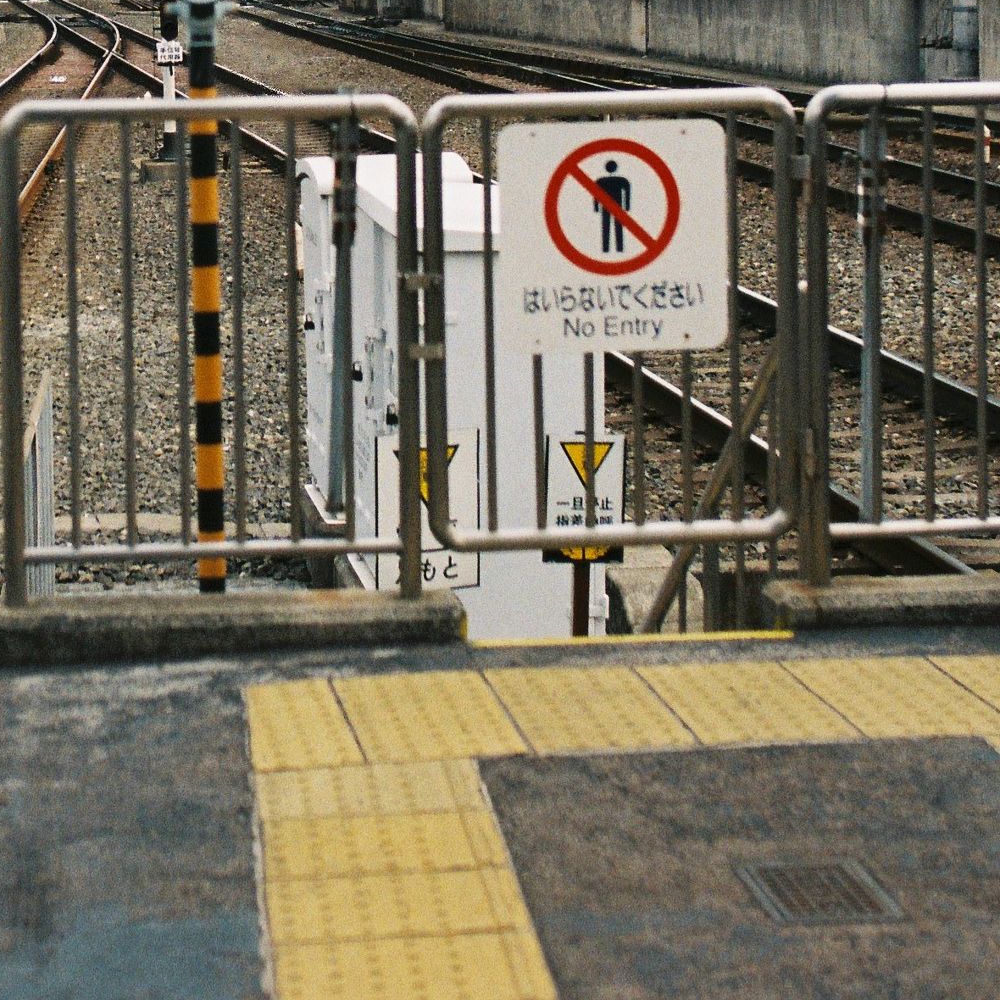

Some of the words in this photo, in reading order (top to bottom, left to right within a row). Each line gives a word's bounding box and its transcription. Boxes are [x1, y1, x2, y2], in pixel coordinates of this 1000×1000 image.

[524, 281, 706, 314] はいらないでください
[563, 318, 595, 338] No
[604, 316, 663, 340] Entry
[555, 495, 613, 511] 一旦止
